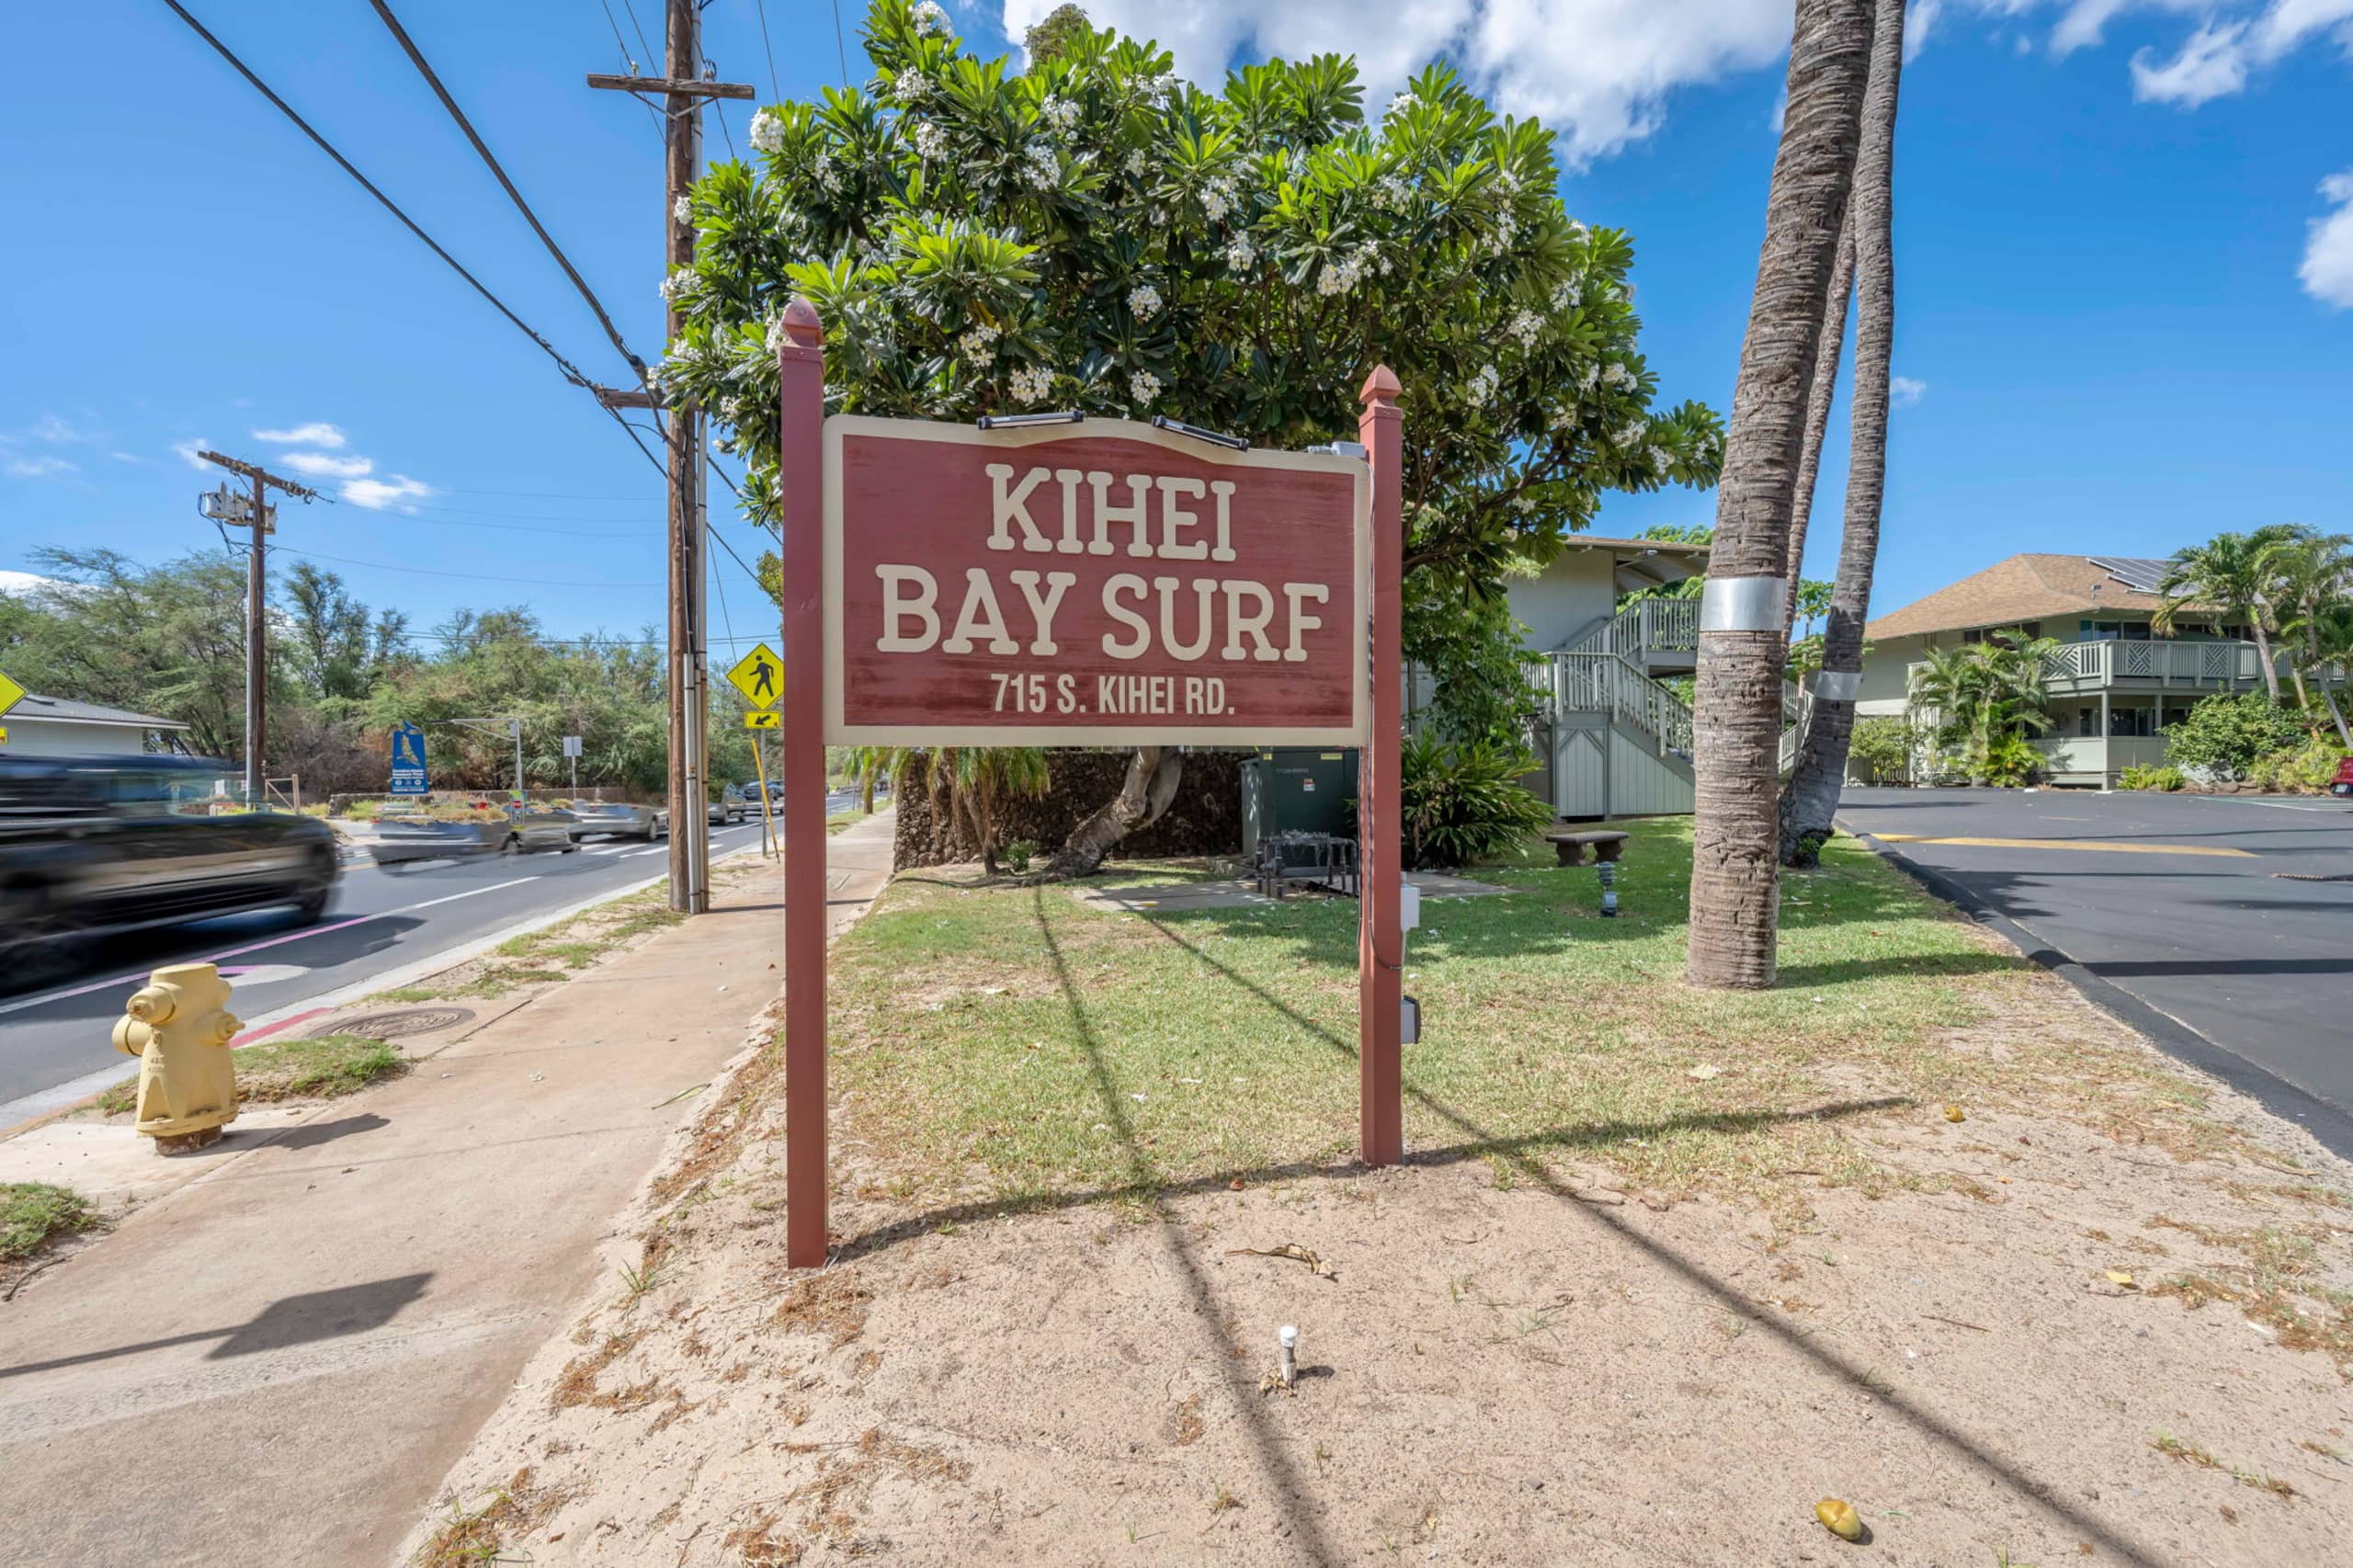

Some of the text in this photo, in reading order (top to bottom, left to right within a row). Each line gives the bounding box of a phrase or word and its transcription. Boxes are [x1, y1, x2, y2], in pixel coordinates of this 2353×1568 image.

[985, 463, 1237, 562] KIHEI
[875, 563, 1329, 662] BAY SURF
[990, 673, 1235, 715] 715 S. KIHEI RD.
